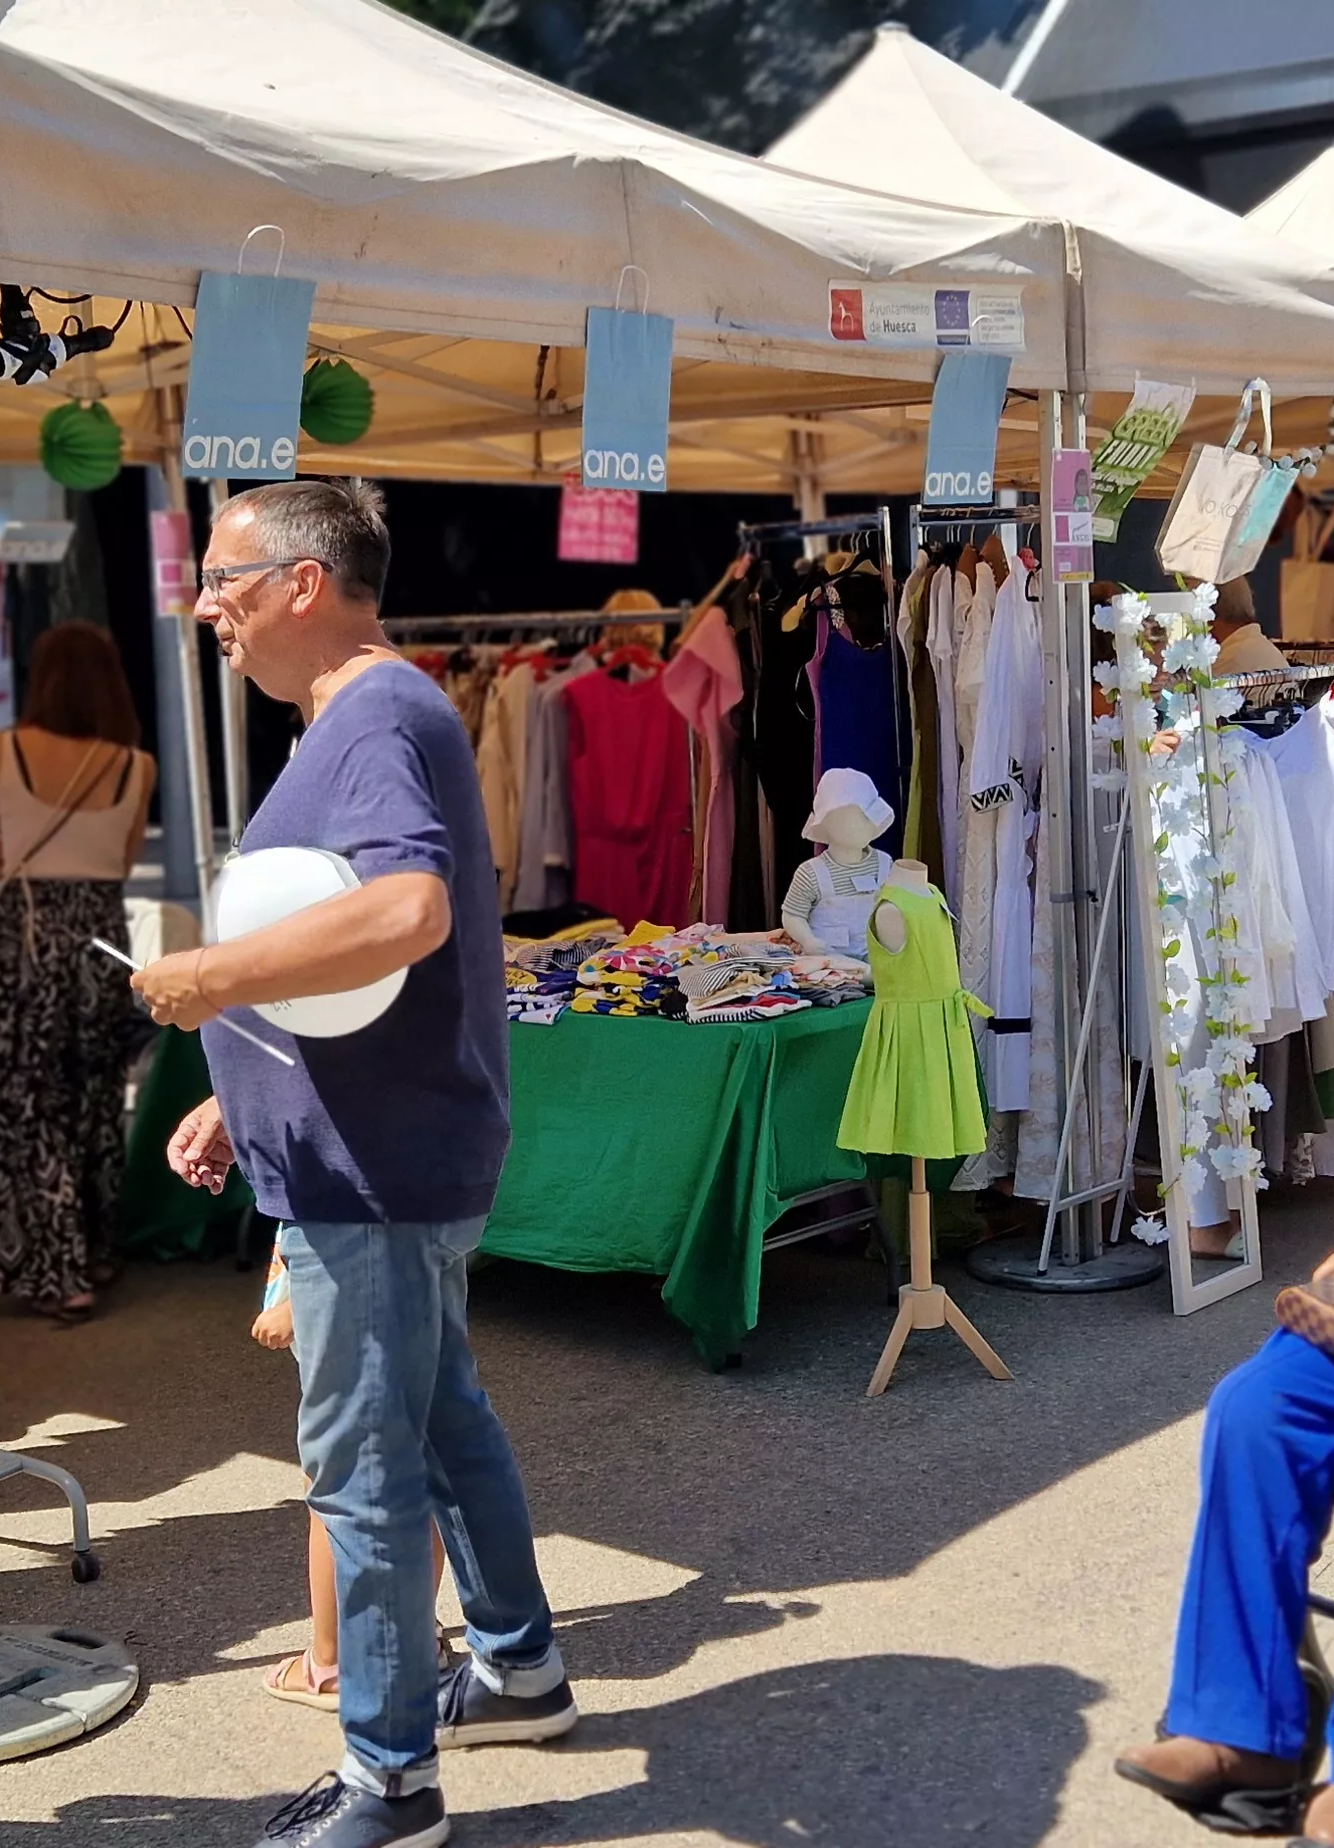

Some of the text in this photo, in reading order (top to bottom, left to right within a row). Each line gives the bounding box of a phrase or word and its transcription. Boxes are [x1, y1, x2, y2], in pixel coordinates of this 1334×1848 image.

[869, 302, 930, 317] Ayuntamiento
[869, 321, 917, 333] de Huesca
[184, 435, 295, 470] ana.e
[584, 449, 665, 483] ana.e
[926, 471, 991, 497] ana.e
